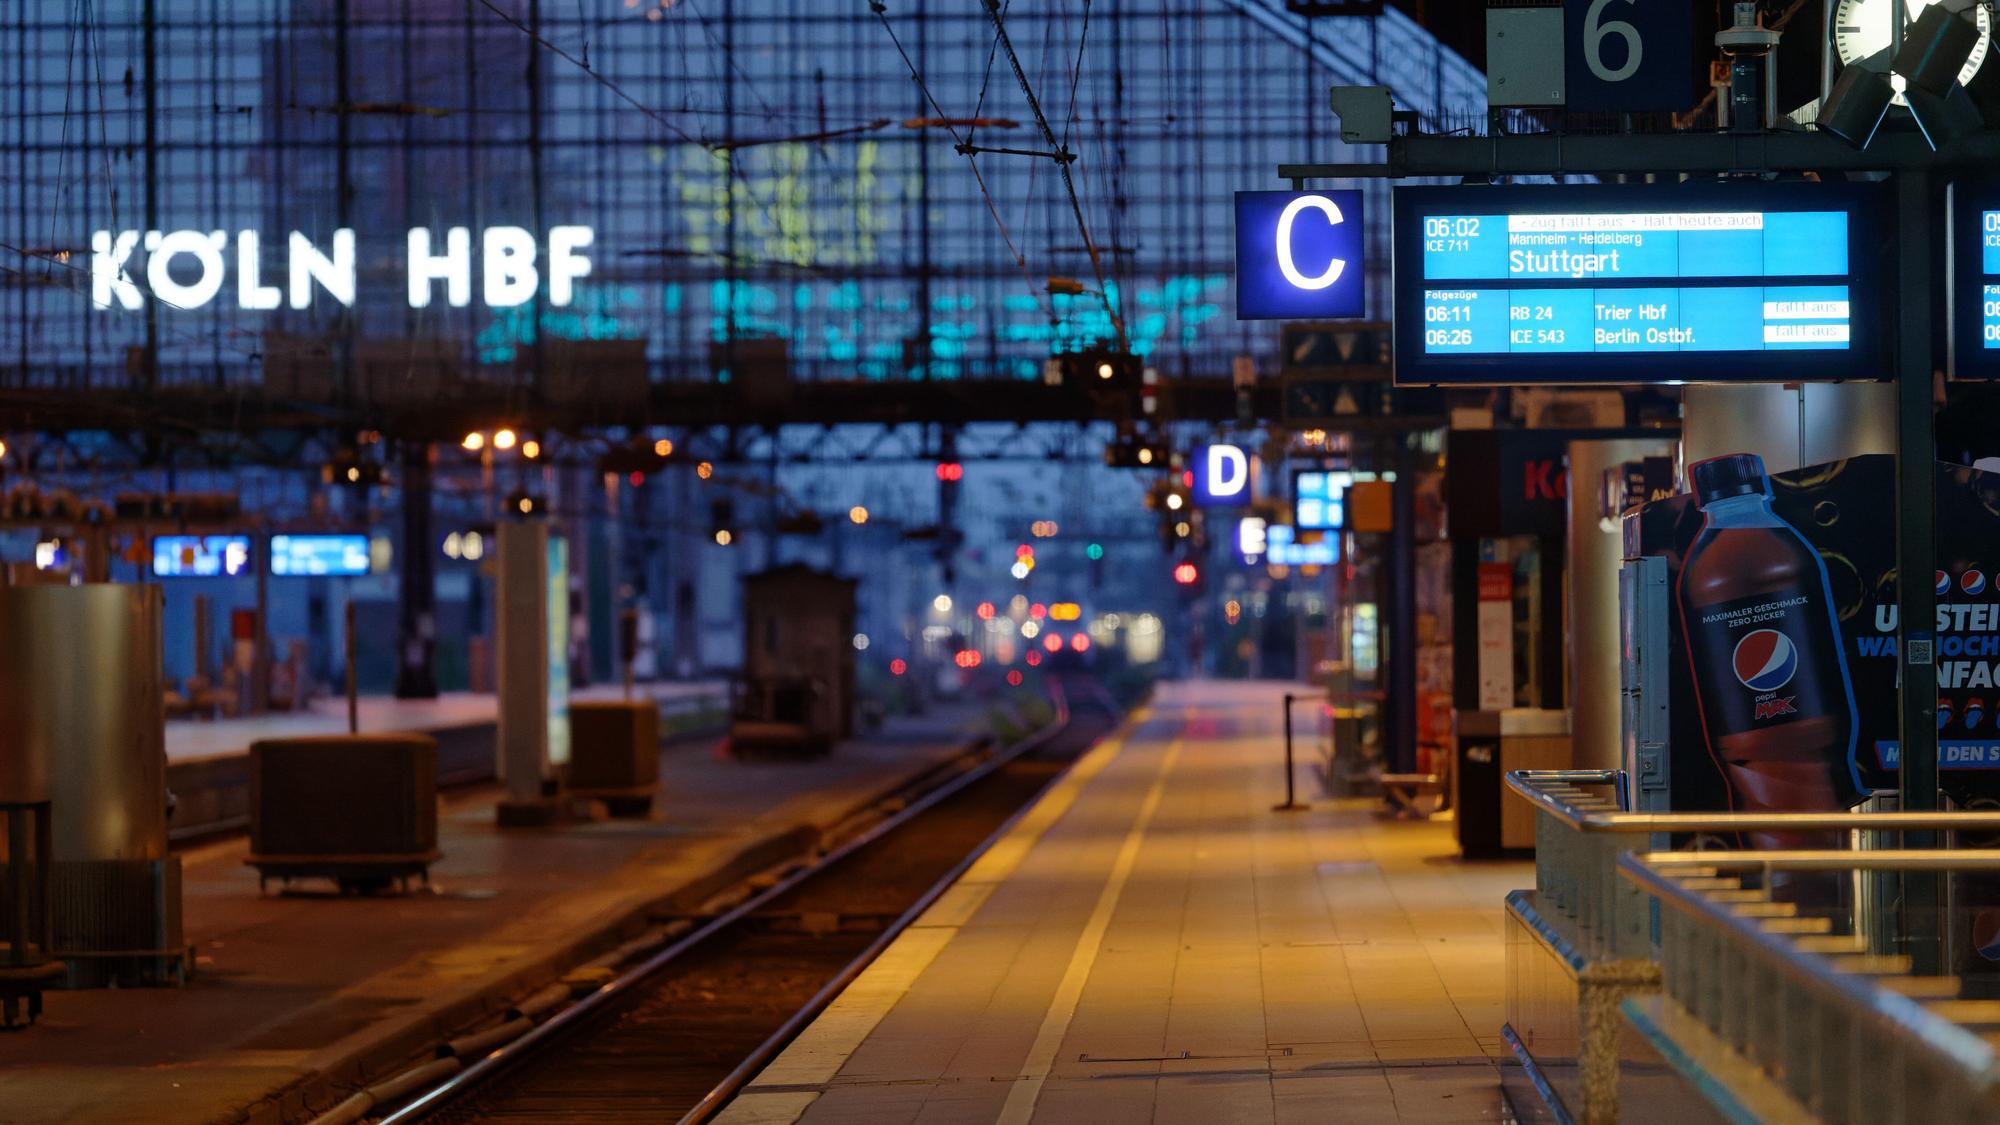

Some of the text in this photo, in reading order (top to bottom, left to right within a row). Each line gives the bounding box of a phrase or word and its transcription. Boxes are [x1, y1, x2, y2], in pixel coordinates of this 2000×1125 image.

[1583, 0, 1643, 81] 6
[1426, 218, 1480, 237] 06:02
[1597, 217, 1623, 227] aus
[1643, 215, 1673, 227] Halt
[1678, 214, 1723, 227] heute
[1727, 213, 1762, 226] auch
[1276, 194, 1346, 290] C
[1426, 240, 1469, 252] ICE 711
[1510, 233, 1567, 245] Mannheim
[1579, 233, 1642, 247] Heidelberg
[92, 225, 594, 310] KÖLN HBF
[1510, 249, 1620, 278] Stuttgart
[1425, 290, 1478, 301] Folgezüge
[1425, 306, 1471, 322] 06:11
[1511, 306, 1553, 320] RB 24
[1595, 304, 1668, 320] Trier Hbf
[1811, 303, 1837, 313] aus
[1425, 329, 1472, 345] 06:26
[1511, 330, 1565, 344] ICE 543
[1595, 328, 1696, 344] Berlin Ostbf.
[1811, 326, 1837, 336] aus
[1208, 444, 1248, 496] D
[1702, 596, 1809, 624] MAXIMALER GESCHMACK
[1728, 610, 1786, 628] ZERO ZUCKER
[1755, 691, 1777, 703] pepsi
[1946, 746, 1984, 762] DEN
